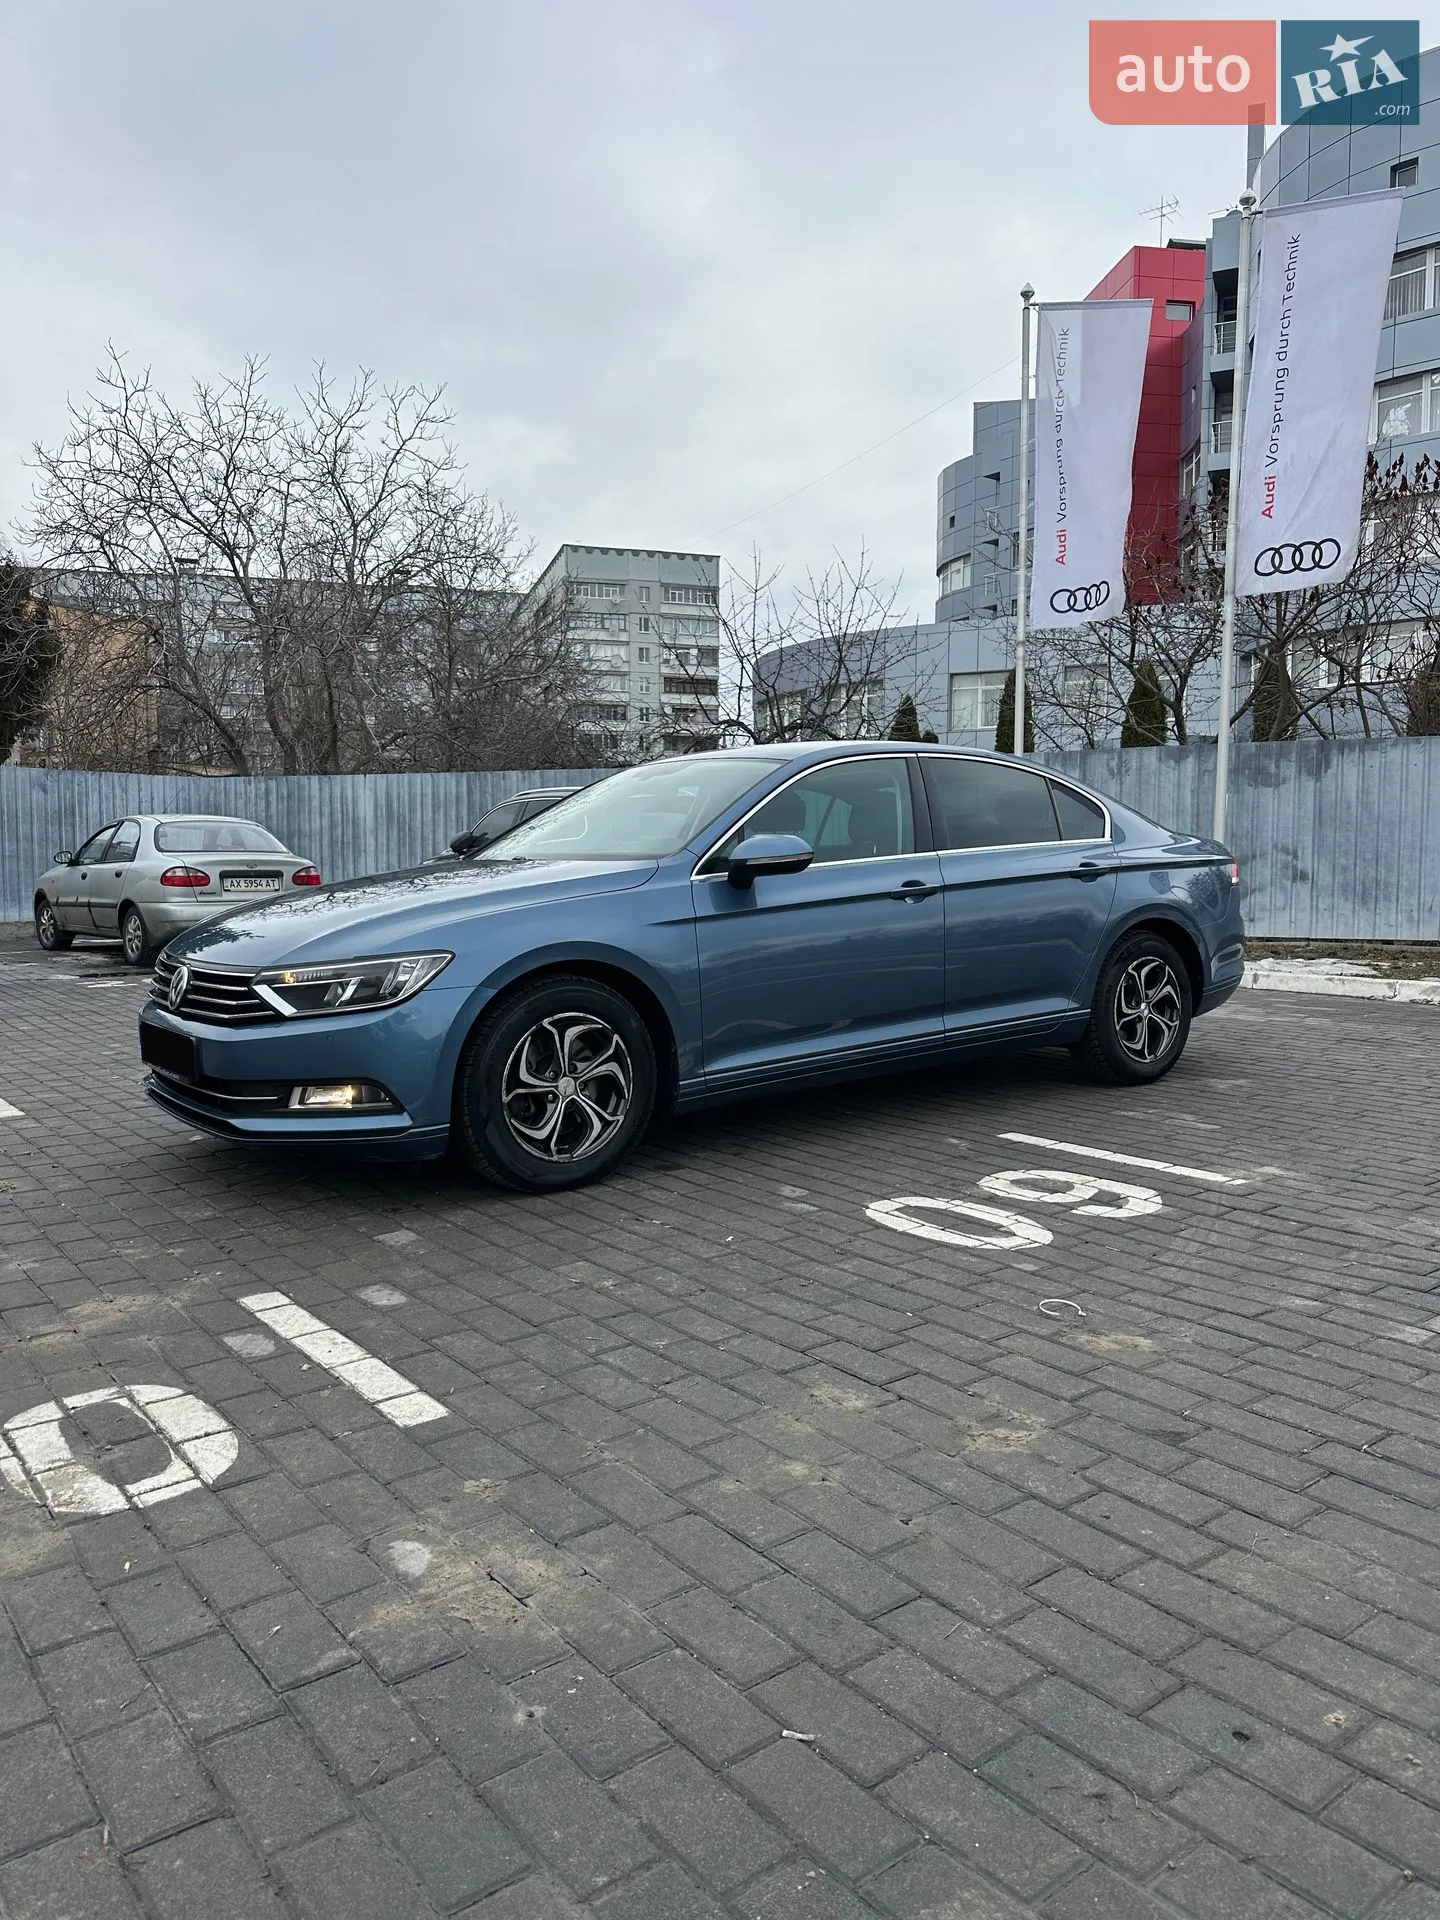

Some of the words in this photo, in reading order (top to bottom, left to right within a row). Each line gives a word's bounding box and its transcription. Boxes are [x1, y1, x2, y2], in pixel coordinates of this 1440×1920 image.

[1281, 233, 1301, 306] Technik
[1056, 327, 1070, 387] Technik
[1275, 308, 1292, 362] durch
[1054, 389, 1065, 434] durch
[1264, 367, 1289, 468] Vorsprung
[1055, 438, 1067, 523] Vorsprung
[1261, 474, 1277, 519] Audi
[1055, 528, 1067, 566] Audi
